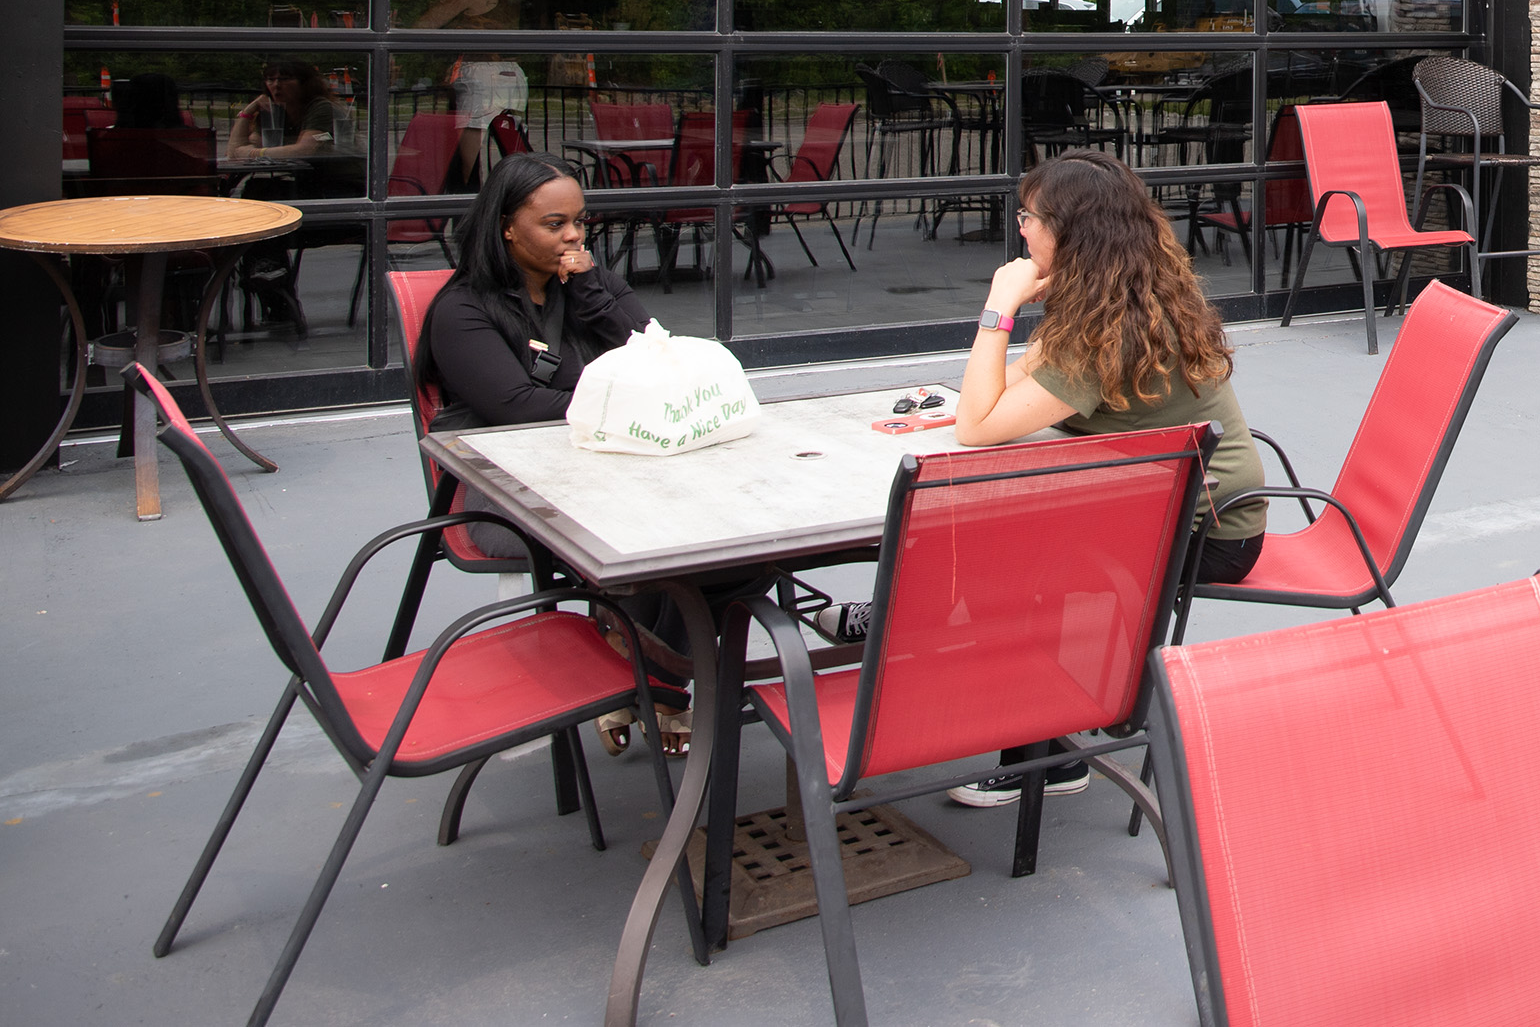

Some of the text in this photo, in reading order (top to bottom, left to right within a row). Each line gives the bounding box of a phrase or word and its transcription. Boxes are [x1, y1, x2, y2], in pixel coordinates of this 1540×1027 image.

[694, 383, 722, 407] You
[628, 396, 747, 449] Have a Nice Day
